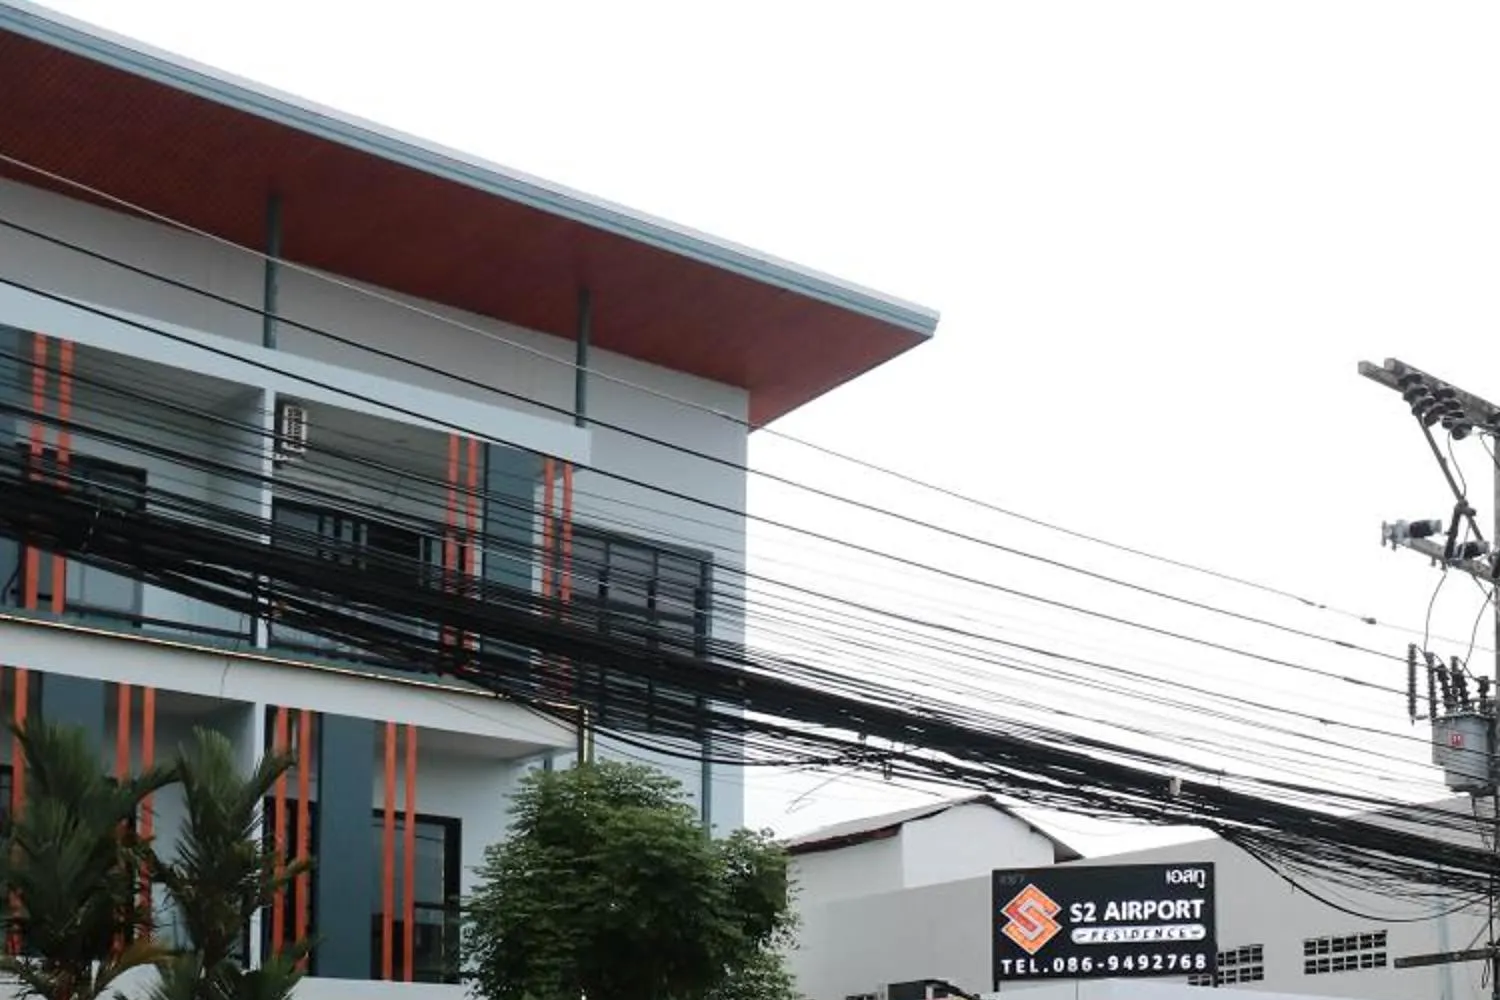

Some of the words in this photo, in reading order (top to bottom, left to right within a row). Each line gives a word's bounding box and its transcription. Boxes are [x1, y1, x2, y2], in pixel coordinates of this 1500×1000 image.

[1166, 869, 1206, 888] เอสทู
[1069, 902, 1097, 923] S2
[1104, 899, 1204, 921] AIRPORT
